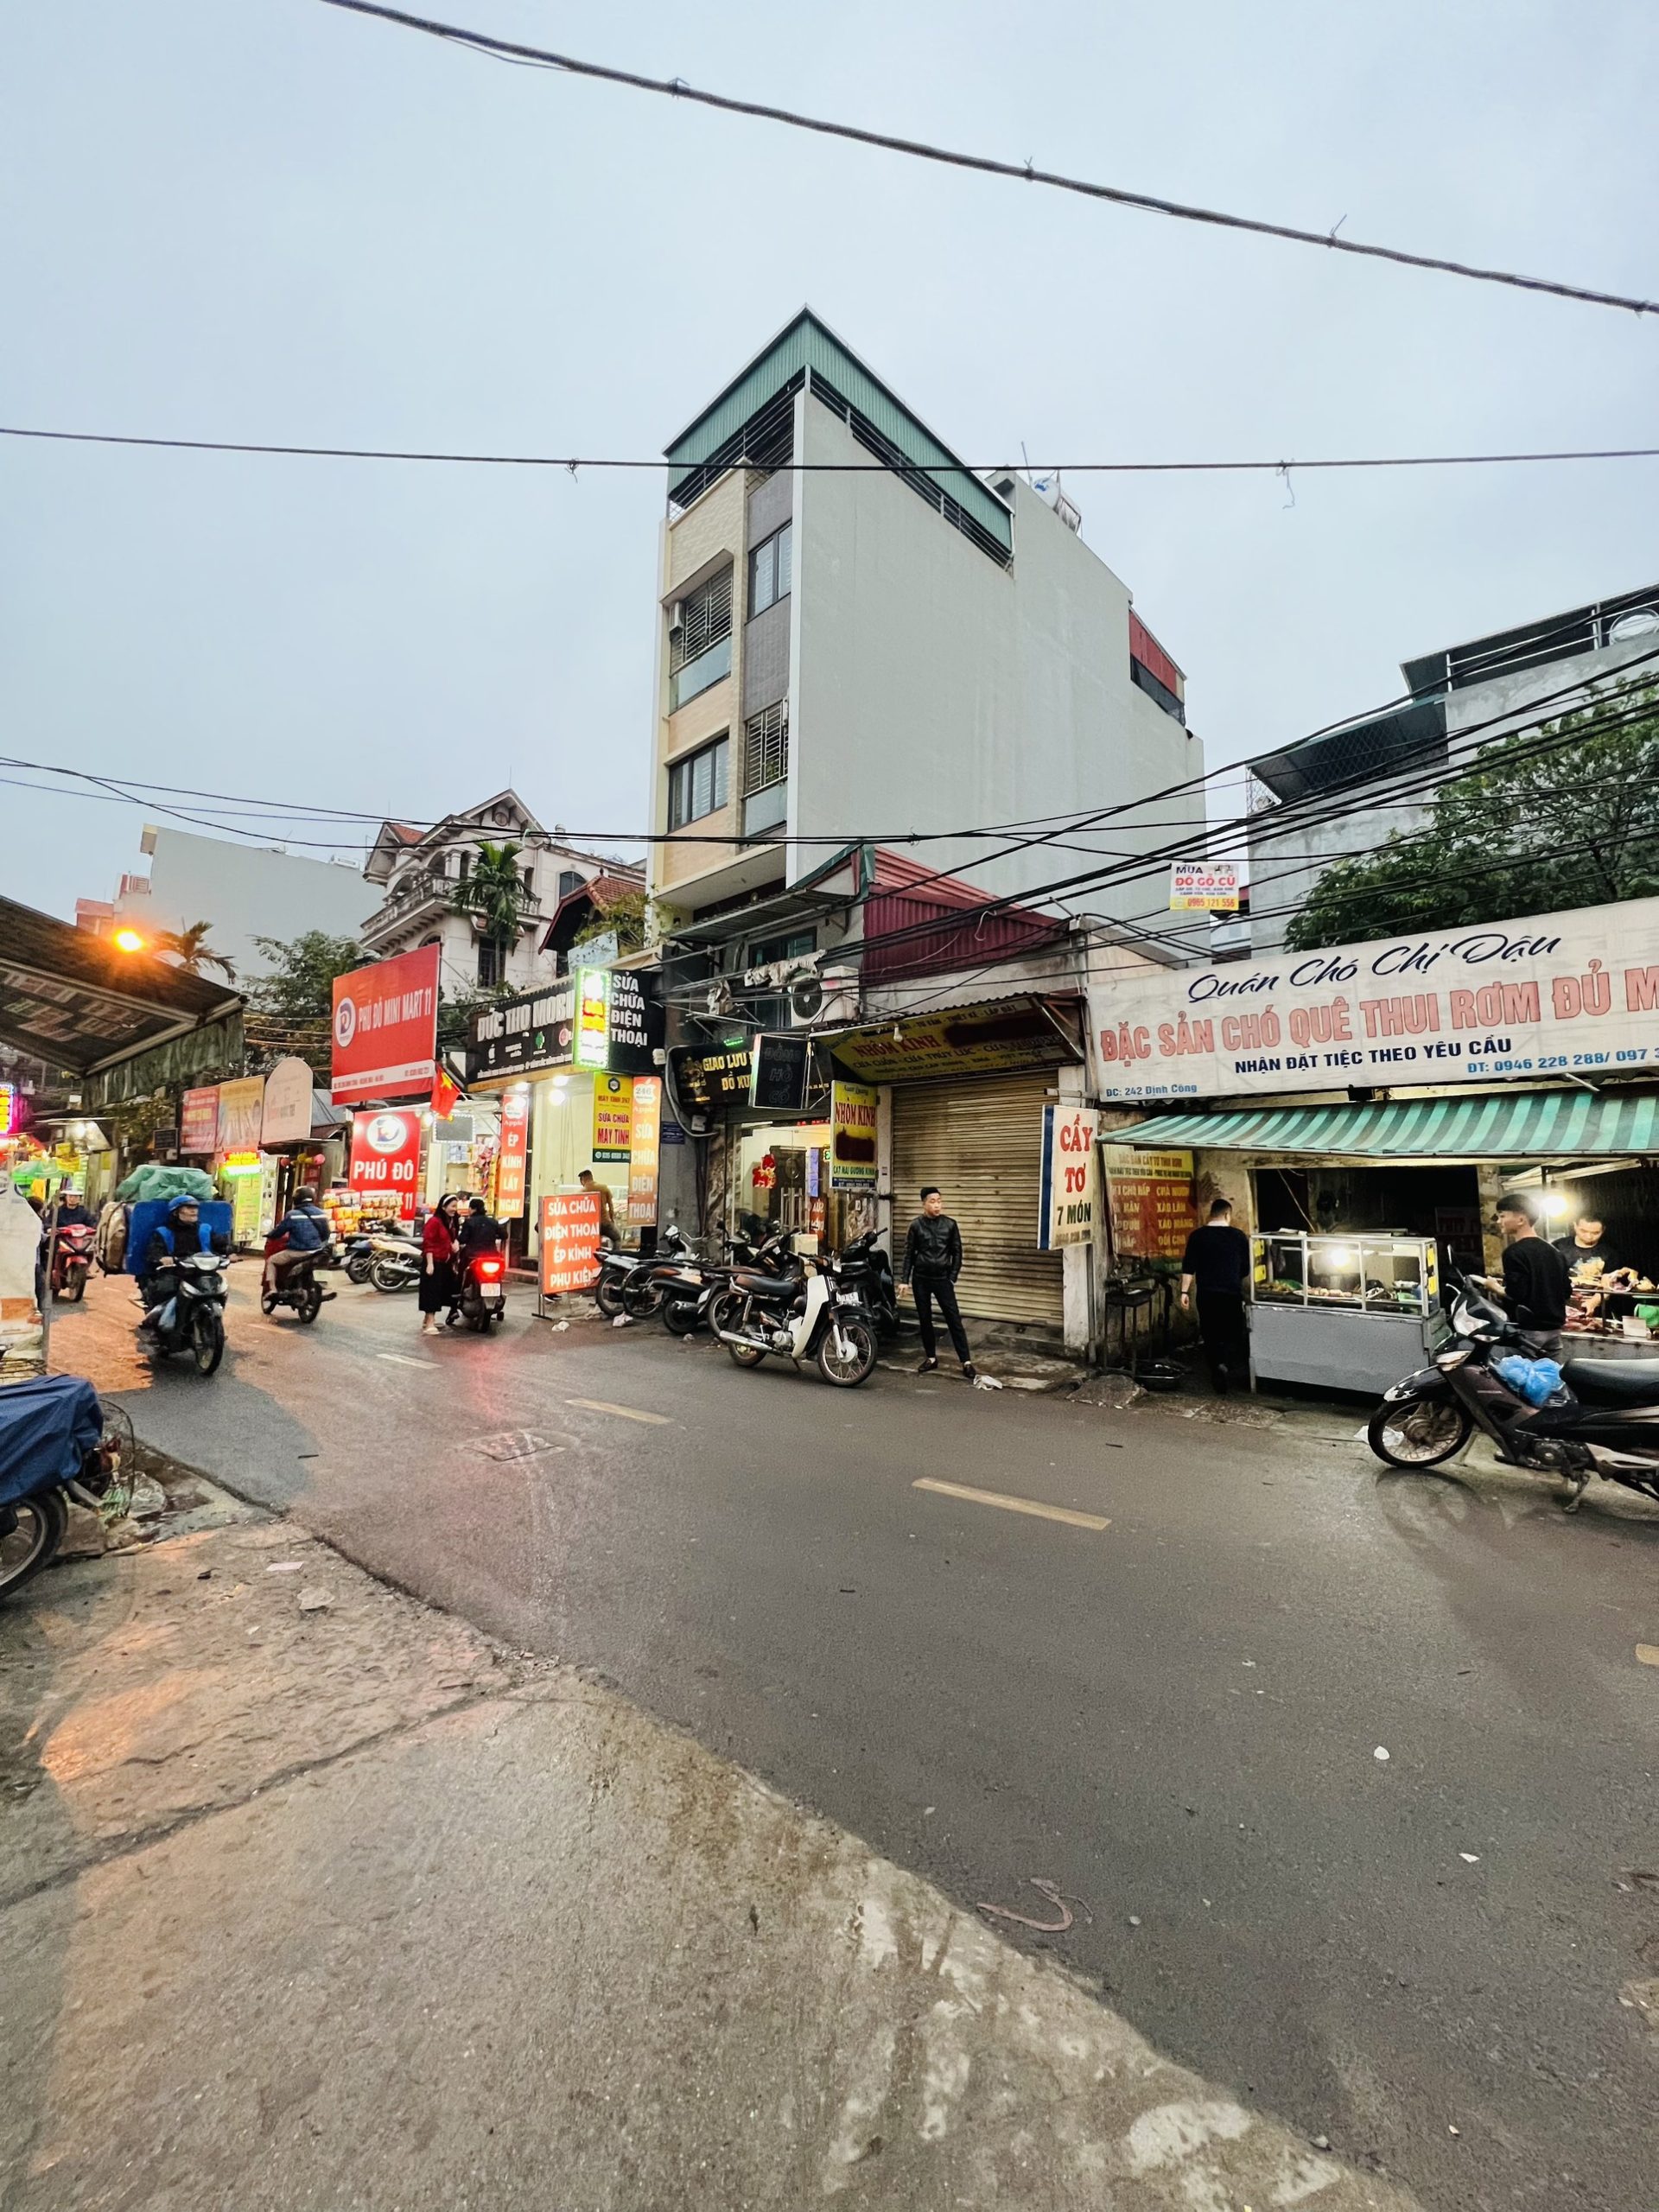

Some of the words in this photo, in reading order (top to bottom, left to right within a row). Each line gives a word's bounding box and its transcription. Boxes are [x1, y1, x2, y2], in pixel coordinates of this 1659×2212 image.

[1176, 866, 1204, 874] MUA
[1218, 874, 1236, 886] CŨ
[613, 971, 639, 992] SỬA
[1188, 973, 1280, 1003] Quán
[1289, 956, 1358, 988] Chó
[1371, 943, 1449, 974] Chị
[358, 999, 372, 1033] PHÚ
[384, 995, 401, 1027] MINI
[402, 988, 423, 1022] MART
[424, 987, 432, 1016] 11
[611, 992, 645, 1010] CHỮA
[477, 1007, 505, 1042] ĐỨC
[505, 1003, 531, 1037] THỌ
[611, 1009, 642, 1028] ĐIỆN
[1100, 1021, 1152, 1067] ĐẶC
[1158, 1010, 1215, 1057] SẢN
[1222, 1004, 1281, 1052] CHÓ
[1288, 995, 1353, 1049] QUÊ
[1359, 992, 1440, 1038] THUI
[1449, 982, 1541, 1030] RƠM
[1552, 958, 1611, 1020] ĐỦ
[1624, 964, 1659, 1013] M
[611, 1028, 648, 1047] THOẠI
[852, 1040, 899, 1058] NHÔM
[899, 1033, 942, 1052] KÍNH
[702, 1055, 726, 1071] GIAO
[726, 1051, 747, 1068] LƯU
[1235, 1057, 1281, 1074] NHẬN
[1287, 1054, 1319, 1071] ĐẶT
[1323, 1049, 1363, 1069] TIỆC
[1369, 1046, 1417, 1063] THEO
[1425, 1039, 1461, 1058] YÊU
[1469, 1034, 1511, 1055] CẦU
[1467, 1061, 1489, 1073] ĐT:
[1495, 1058, 1533, 1071] 0946
[1538, 1056, 1568, 1069] 228
[1573, 1051, 1611, 1065] 288/
[1616, 1048, 1648, 1061] 097
[736, 1074, 752, 1089] XU
[1106, 1088, 1122, 1097] ĐC:
[1125, 1087, 1142, 1096] 242
[1146, 1085, 1168, 1096] Định
[1171, 1084, 1198, 1094] Công
[857, 1099, 876, 1127] KÍNH
[507, 1132, 518, 1147] ÉP
[353, 1158, 387, 1180] PHÚ
[391, 1159, 414, 1180] ĐÔ
[502, 1153, 522, 1168] KÍNH
[1065, 1162, 1086, 1193] TƠ
[404, 1192, 413, 1210] 11
[548, 1197, 568, 1217] SỬA
[629, 1202, 655, 1222] THOẠI
[1057, 1206, 1063, 1225] 7
[1066, 1199, 1091, 1224] MÓN
[544, 1222, 569, 1243] ĐIỆN
[570, 1221, 600, 1239] THOẠI
[554, 1246, 566, 1263] ÉP
[569, 1243, 591, 1262] KÍNH
[550, 1271, 571, 1289] PHỤ
